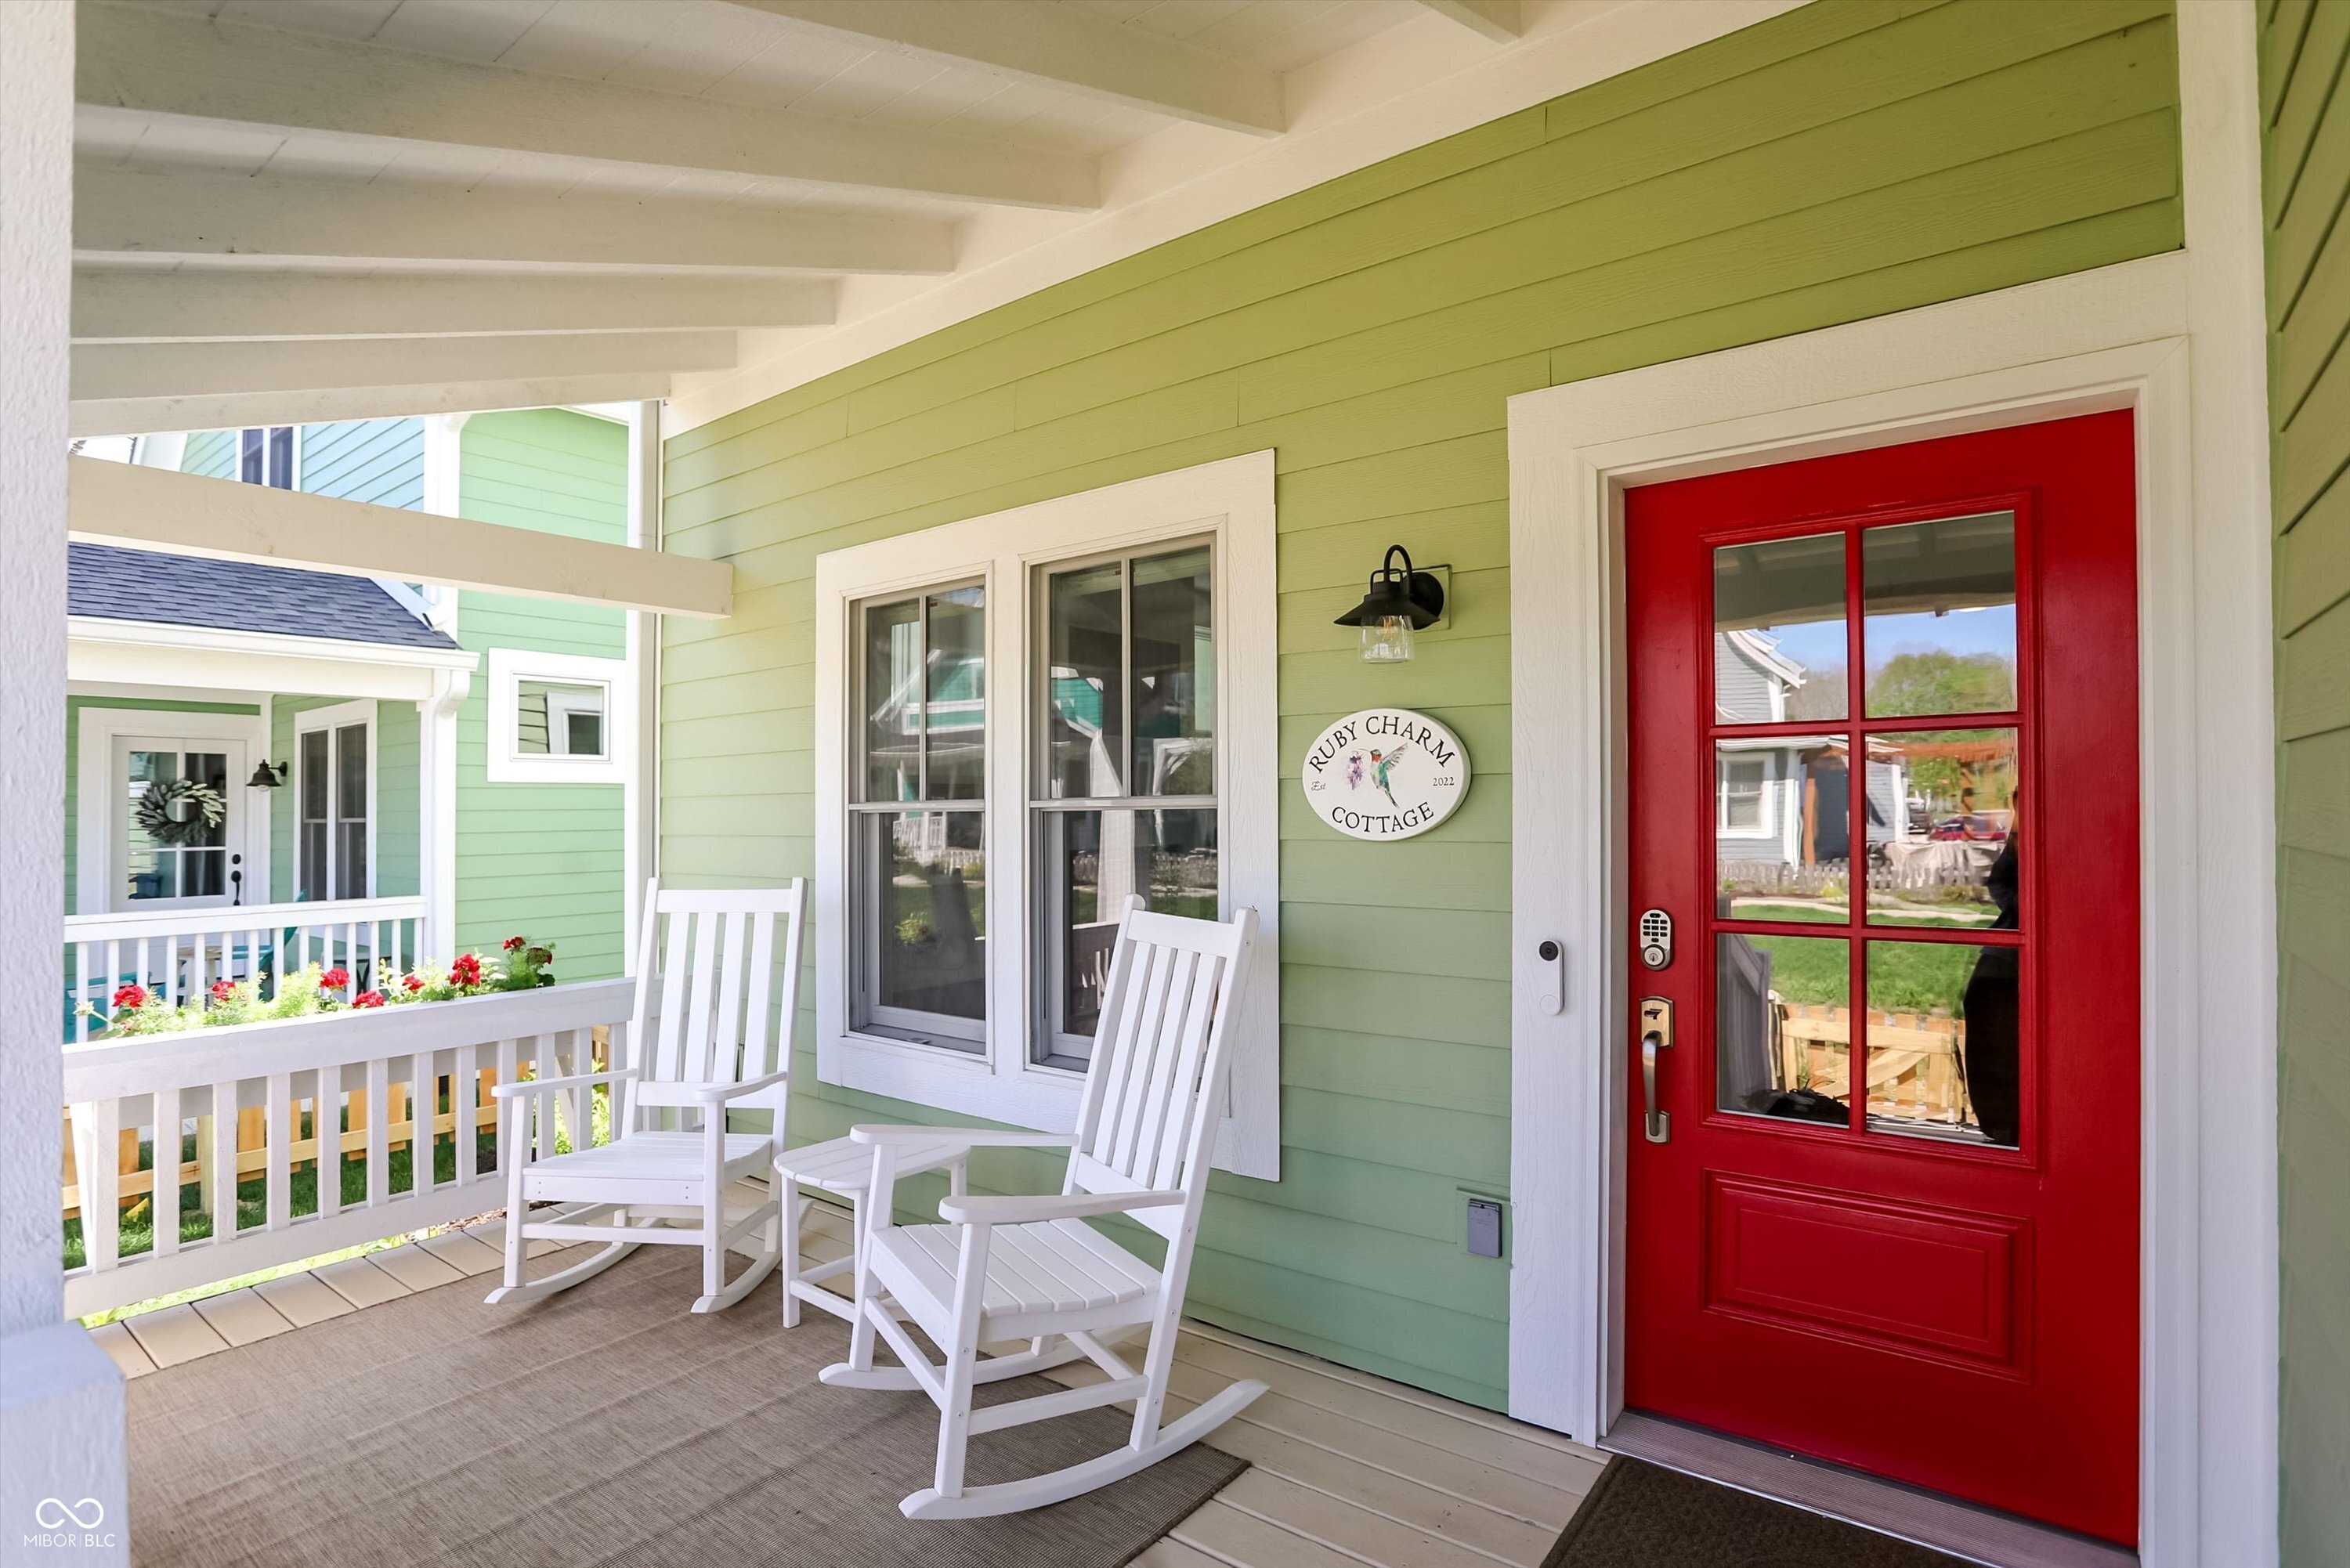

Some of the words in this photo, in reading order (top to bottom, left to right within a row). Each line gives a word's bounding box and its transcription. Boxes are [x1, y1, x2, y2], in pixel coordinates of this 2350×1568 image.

[1309, 721, 1358, 773] RUBY
[1365, 716, 1455, 768] CHARM
[1432, 776, 1455, 786] 2022
[1332, 801, 1434, 833] COTTAGE
